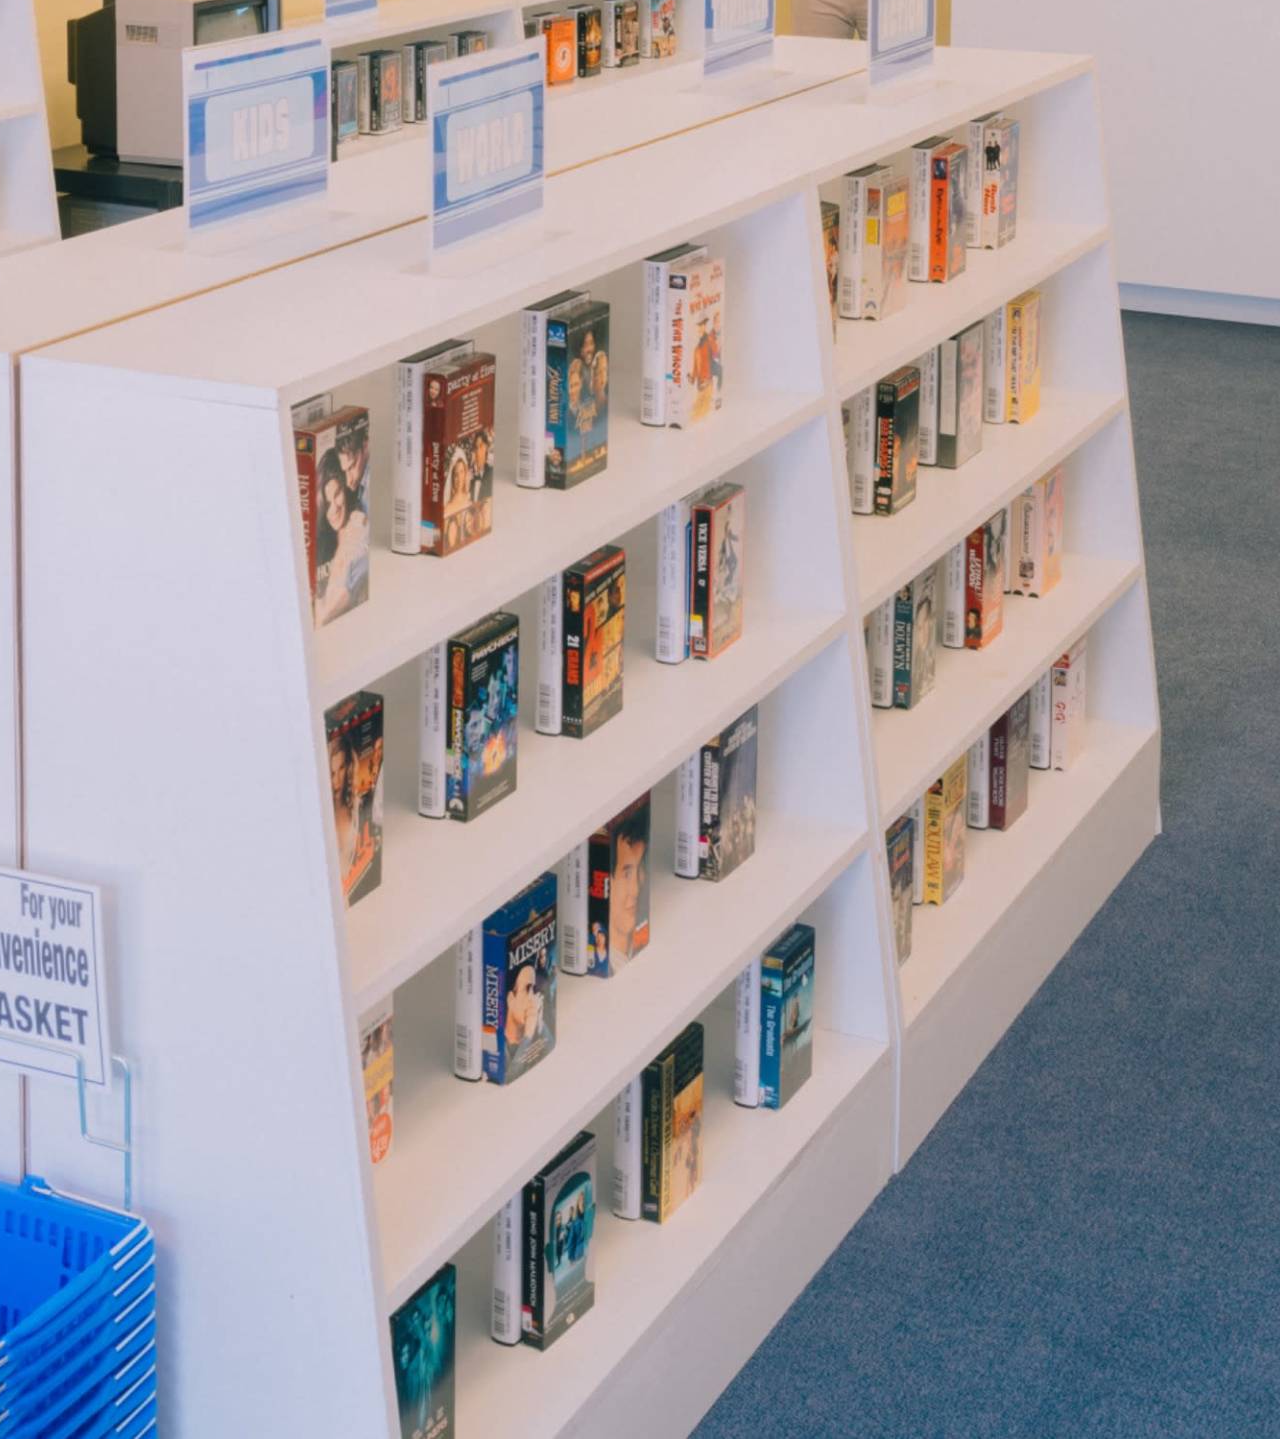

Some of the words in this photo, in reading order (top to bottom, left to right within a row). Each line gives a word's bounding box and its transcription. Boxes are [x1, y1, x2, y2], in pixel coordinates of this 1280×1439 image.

[232, 96, 290, 160] KIDS
[448, 373, 470, 395] party
[480, 365, 495, 380] five
[299, 474, 310, 512] HOPE
[698, 522, 707, 544] VICE
[698, 546, 707, 571] VERSA
[968, 549, 976, 587] WEAPON
[974, 557, 982, 590] LETHAL
[471, 630, 518, 662] PAYCHECK
[567, 635, 579, 647] 21
[895, 620, 906, 670] DOLWYN
[567, 649, 579, 685] GRAMS
[928, 824, 940, 876] OUTLAW
[20, 883, 45, 920] For
[48, 895, 83, 929] your
[508, 921, 556, 969] MISERY
[486, 965, 499, 1027] MISERY
[766, 1005, 776, 1018] The
[766, 1020, 776, 1056] Graduate
[529, 1211, 537, 1235] BEING
[529, 1236, 537, 1259] JOHN
[529, 1260, 537, 1306] MALKOVICH
